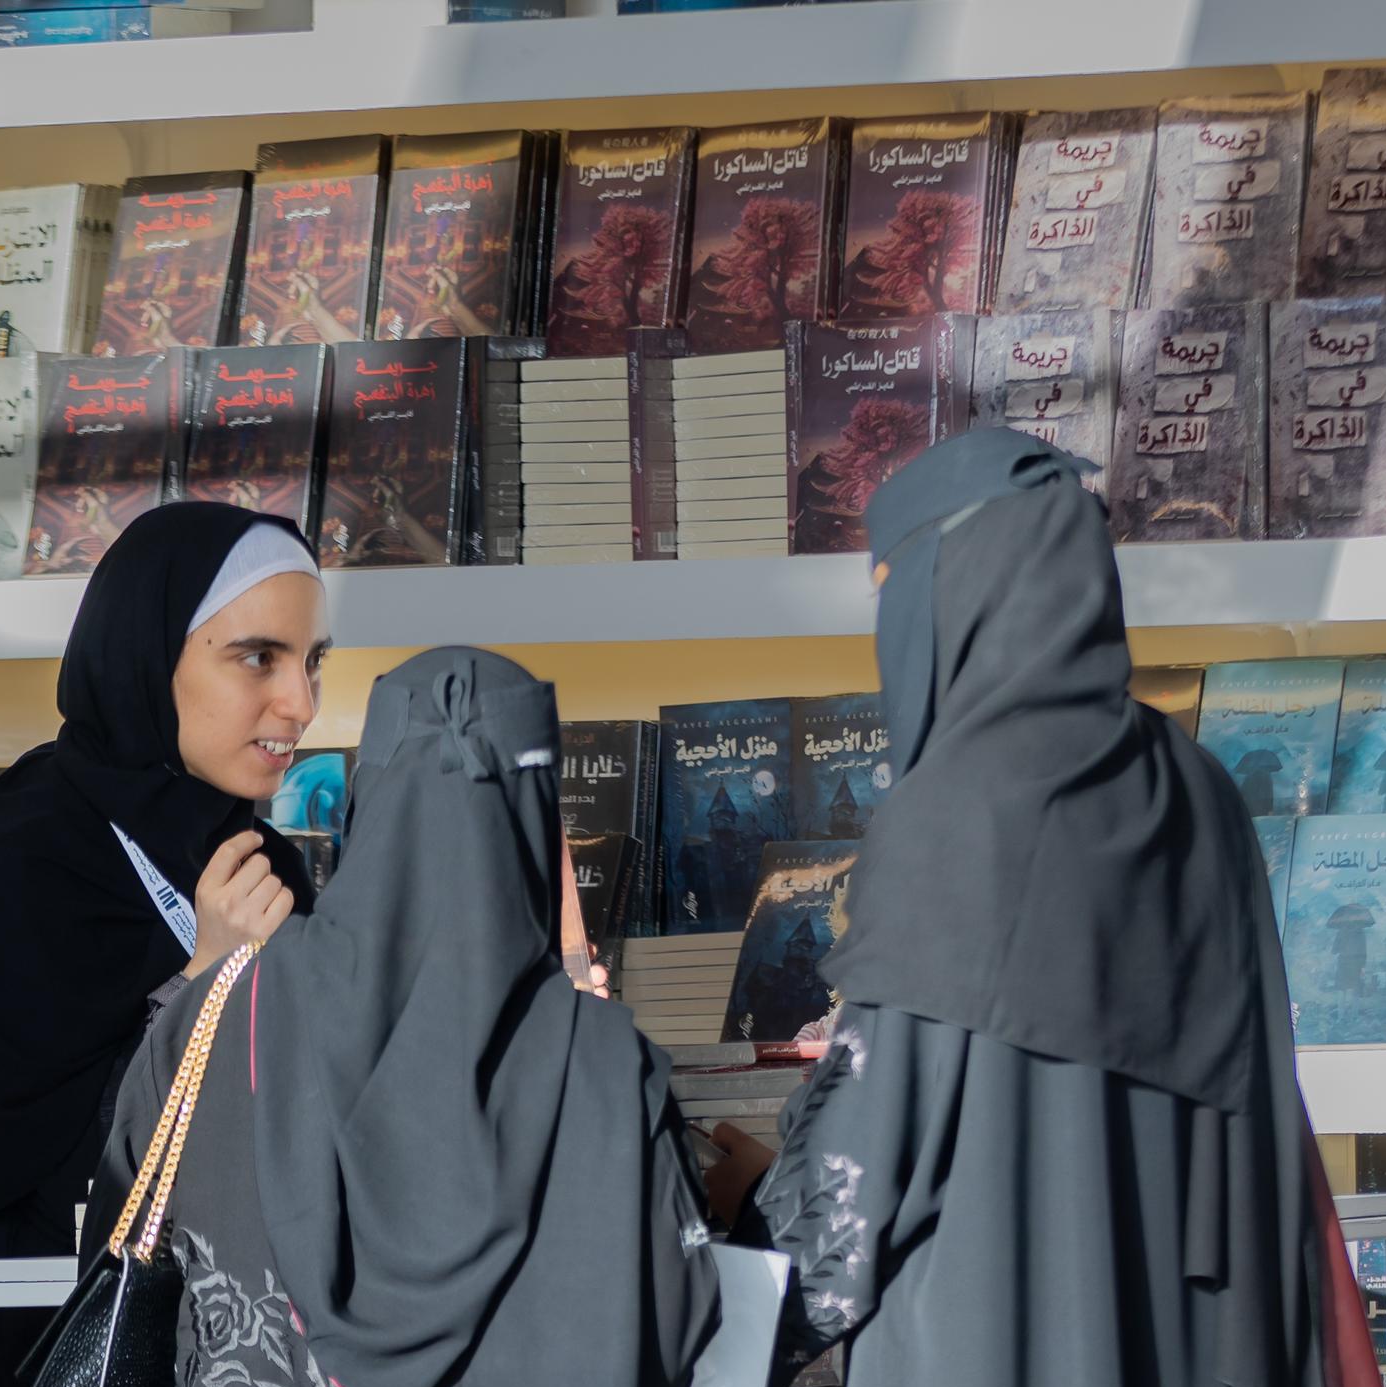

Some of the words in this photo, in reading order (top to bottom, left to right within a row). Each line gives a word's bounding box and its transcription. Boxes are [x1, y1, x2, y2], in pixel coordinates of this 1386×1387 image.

[1058, 137, 1112, 160] جريمة
[1199, 122, 1260, 149] جريمة
[714, 152, 772, 183] الساكورا
[775, 146, 808, 174] قاتل
[869, 143, 930, 174] الساكورا
[931, 139, 969, 168] قاتل
[579, 159, 632, 186] الساكورا
[633, 155, 666, 182] قاتل
[1227, 164, 1256, 198] في
[1076, 174, 1103, 208] في
[1030, 214, 1094, 242] الذاكرة
[1180, 206, 1252, 235] الذاكرة
[1013, 341, 1068, 367] جريمة
[1162, 337, 1219, 363] جريمة
[1309, 330, 1370, 356] جريمة
[821, 350, 883, 379] الساكورا
[883, 346, 922, 374] قاتل
[1035, 384, 1061, 417] في
[1184, 376, 1212, 412] في
[1339, 371, 1366, 406] في
[1140, 421, 1205, 450] الذاكرة
[1294, 419, 1364, 447] الذاكرة
[846, 711, 880, 720] ALGRA
[1221, 697, 1269, 718] المظلة
[1275, 699, 1316, 718] رجل
[676, 734, 737, 767] الأحجية
[741, 736, 778, 759] منزل
[805, 727, 862, 760] الأحجية
[864, 729, 891, 753] نزل
[582, 754, 627, 784] خلايا
[1314, 850, 1363, 871] المظلة
